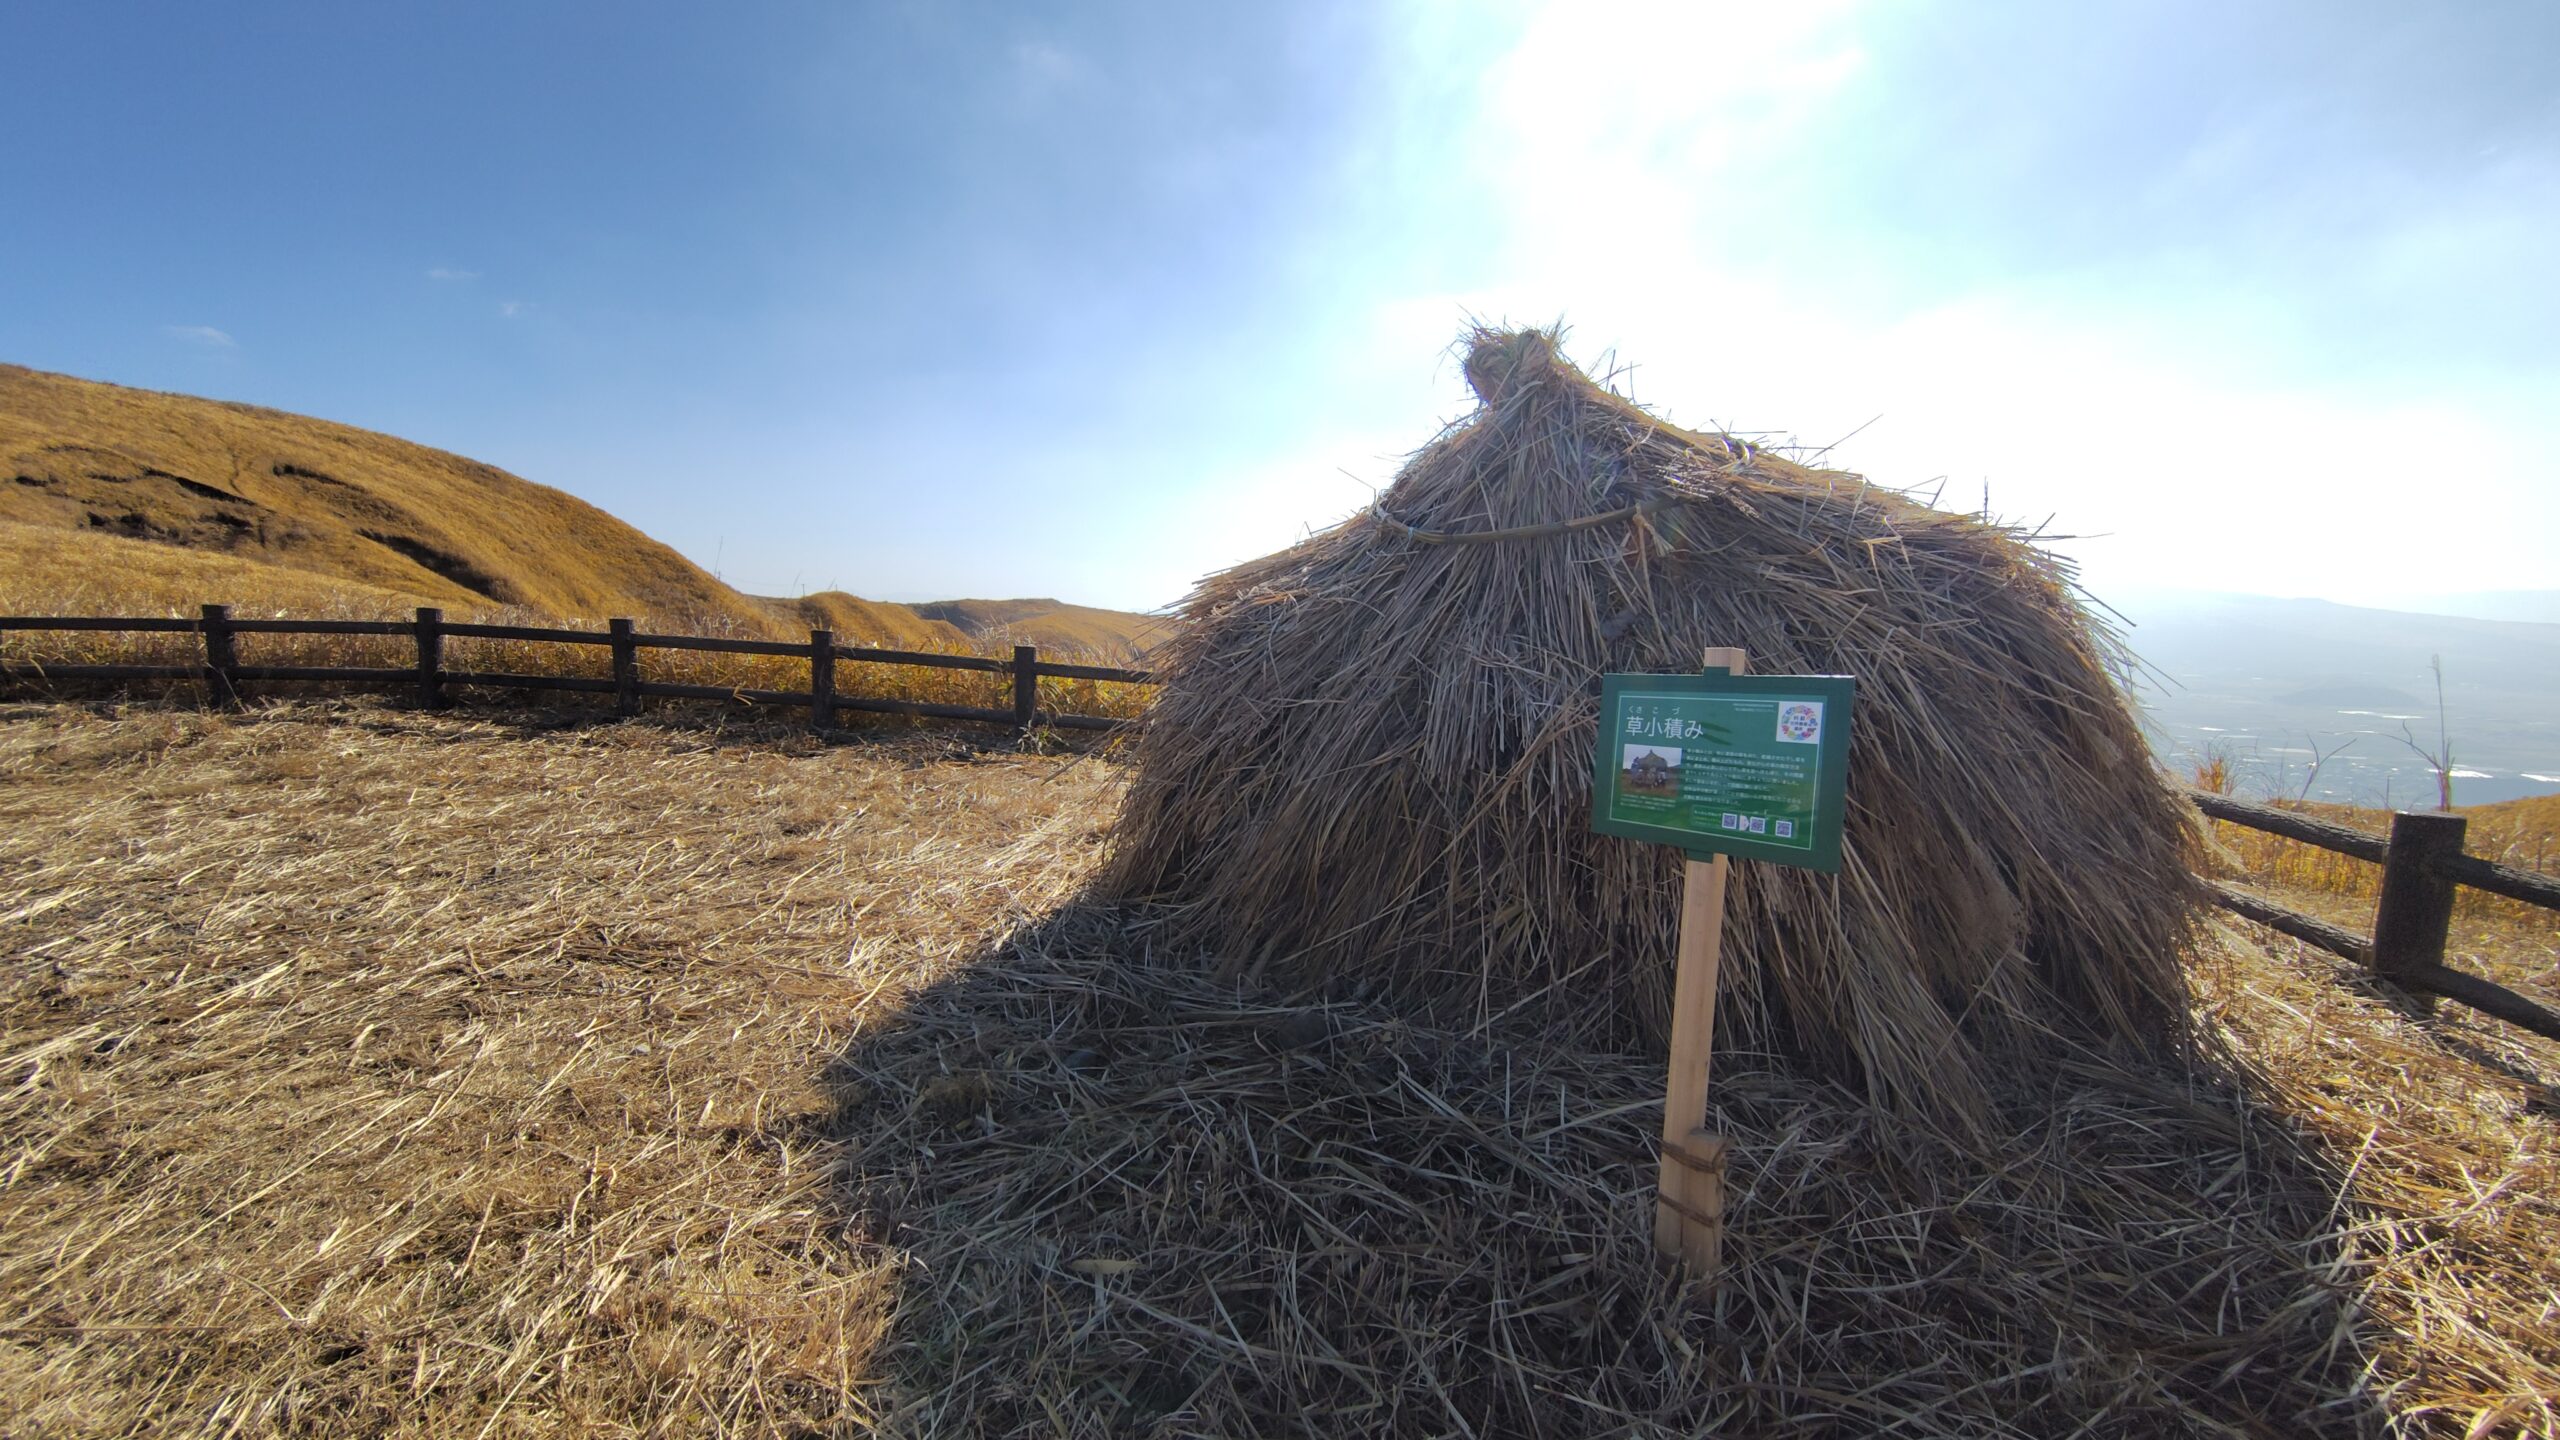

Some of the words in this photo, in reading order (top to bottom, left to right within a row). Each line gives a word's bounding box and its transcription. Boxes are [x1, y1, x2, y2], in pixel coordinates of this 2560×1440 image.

[1628, 705, 1643, 714] くさ
[1652, 706, 1659, 714] こ
[1625, 716, 1704, 739] 草小積み
